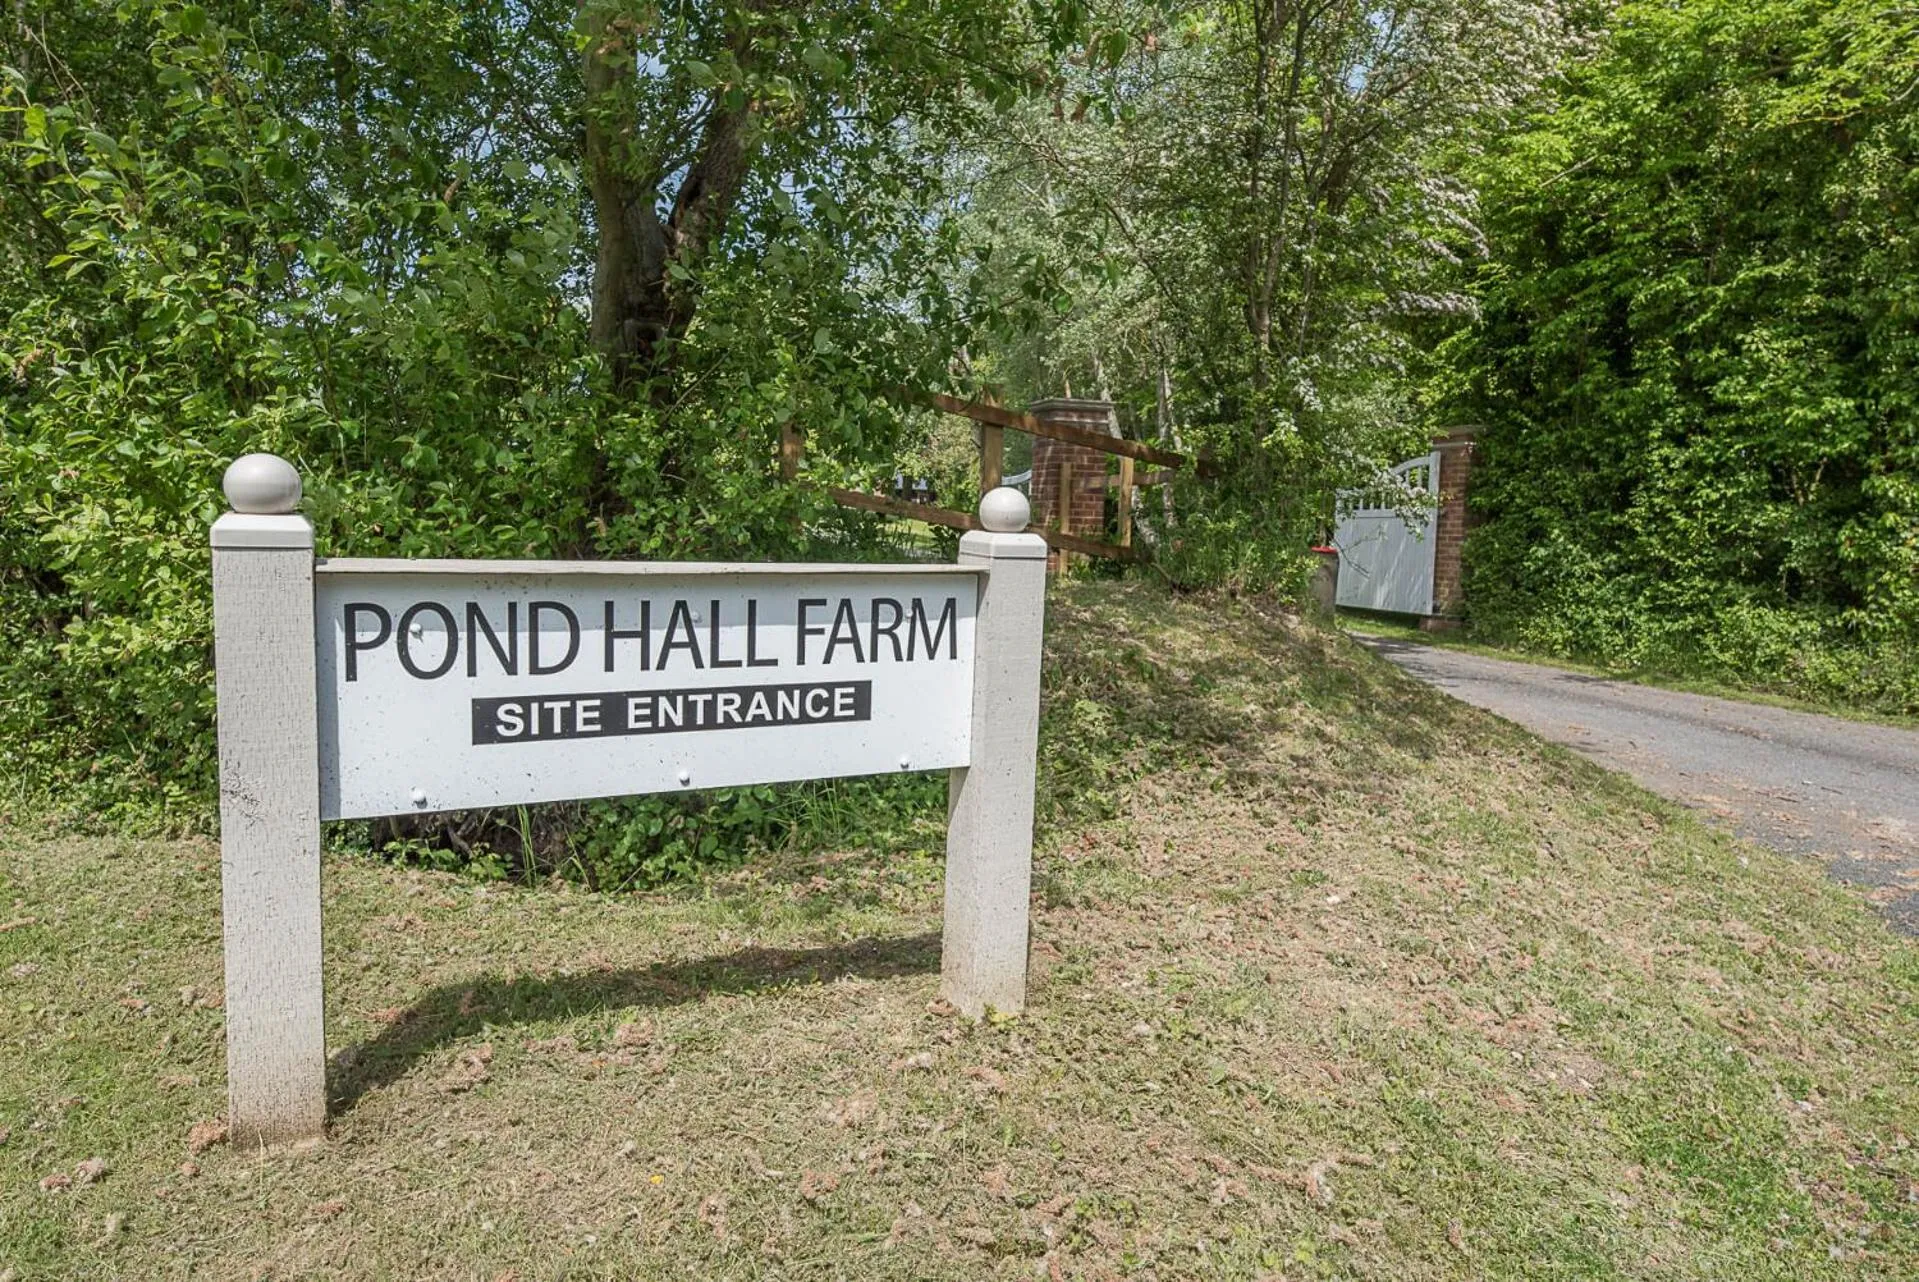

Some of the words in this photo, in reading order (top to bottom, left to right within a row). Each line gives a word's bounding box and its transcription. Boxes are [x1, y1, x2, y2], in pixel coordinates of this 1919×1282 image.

[343, 600, 581, 682] POND
[603, 599, 779, 673] HALL
[796, 597, 957, 666] FARM
[495, 699, 602, 737] SITE
[626, 686, 856, 730] ENTRANCE
